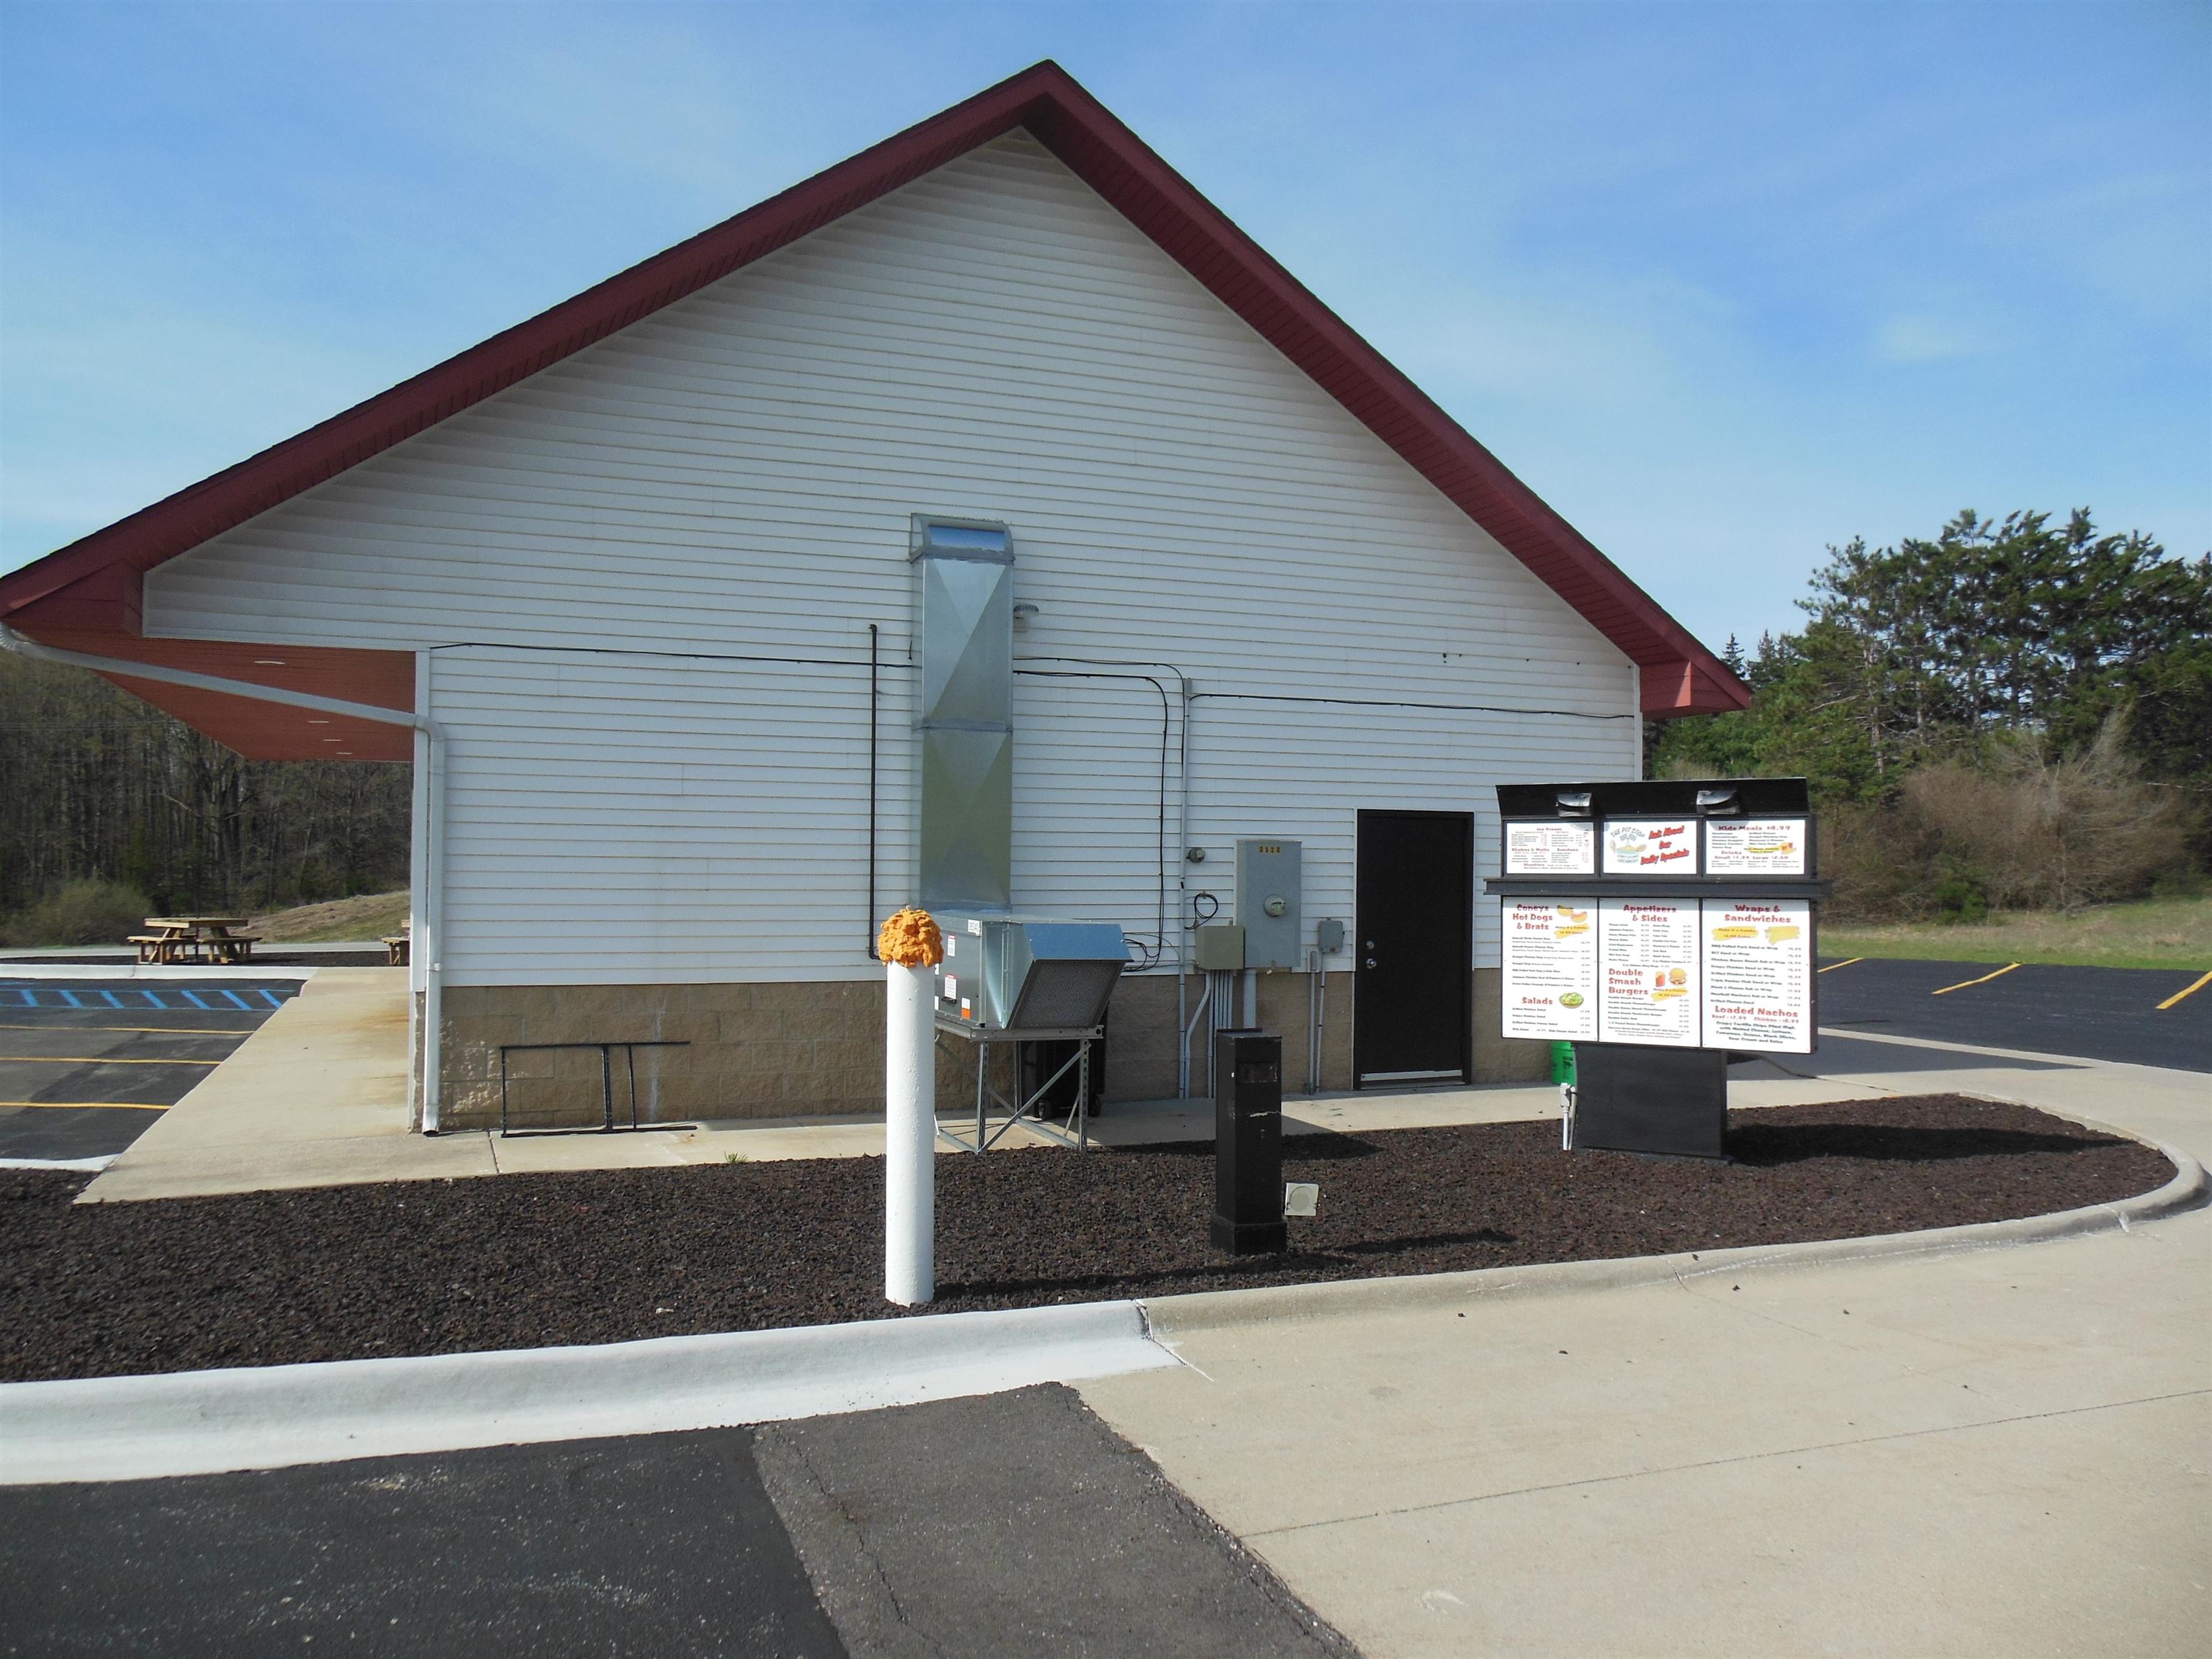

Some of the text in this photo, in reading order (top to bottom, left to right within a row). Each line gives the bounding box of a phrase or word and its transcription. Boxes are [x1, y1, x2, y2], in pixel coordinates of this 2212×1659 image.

[1610, 828, 1620, 837] THE
[1632, 828, 1645, 837] STOP
[1649, 830, 1662, 840] Ask
[1516, 904, 1549, 912] Coneys
[1623, 904, 1676, 913] Appetizers
[1735, 904, 1770, 913] Wraps
[1530, 913, 1553, 922] Dogs
[1724, 914, 1791, 922] Sandwiches
[1609, 986, 1649, 996] Burgers
[1715, 1006, 1798, 1017] Loaded Nachos
